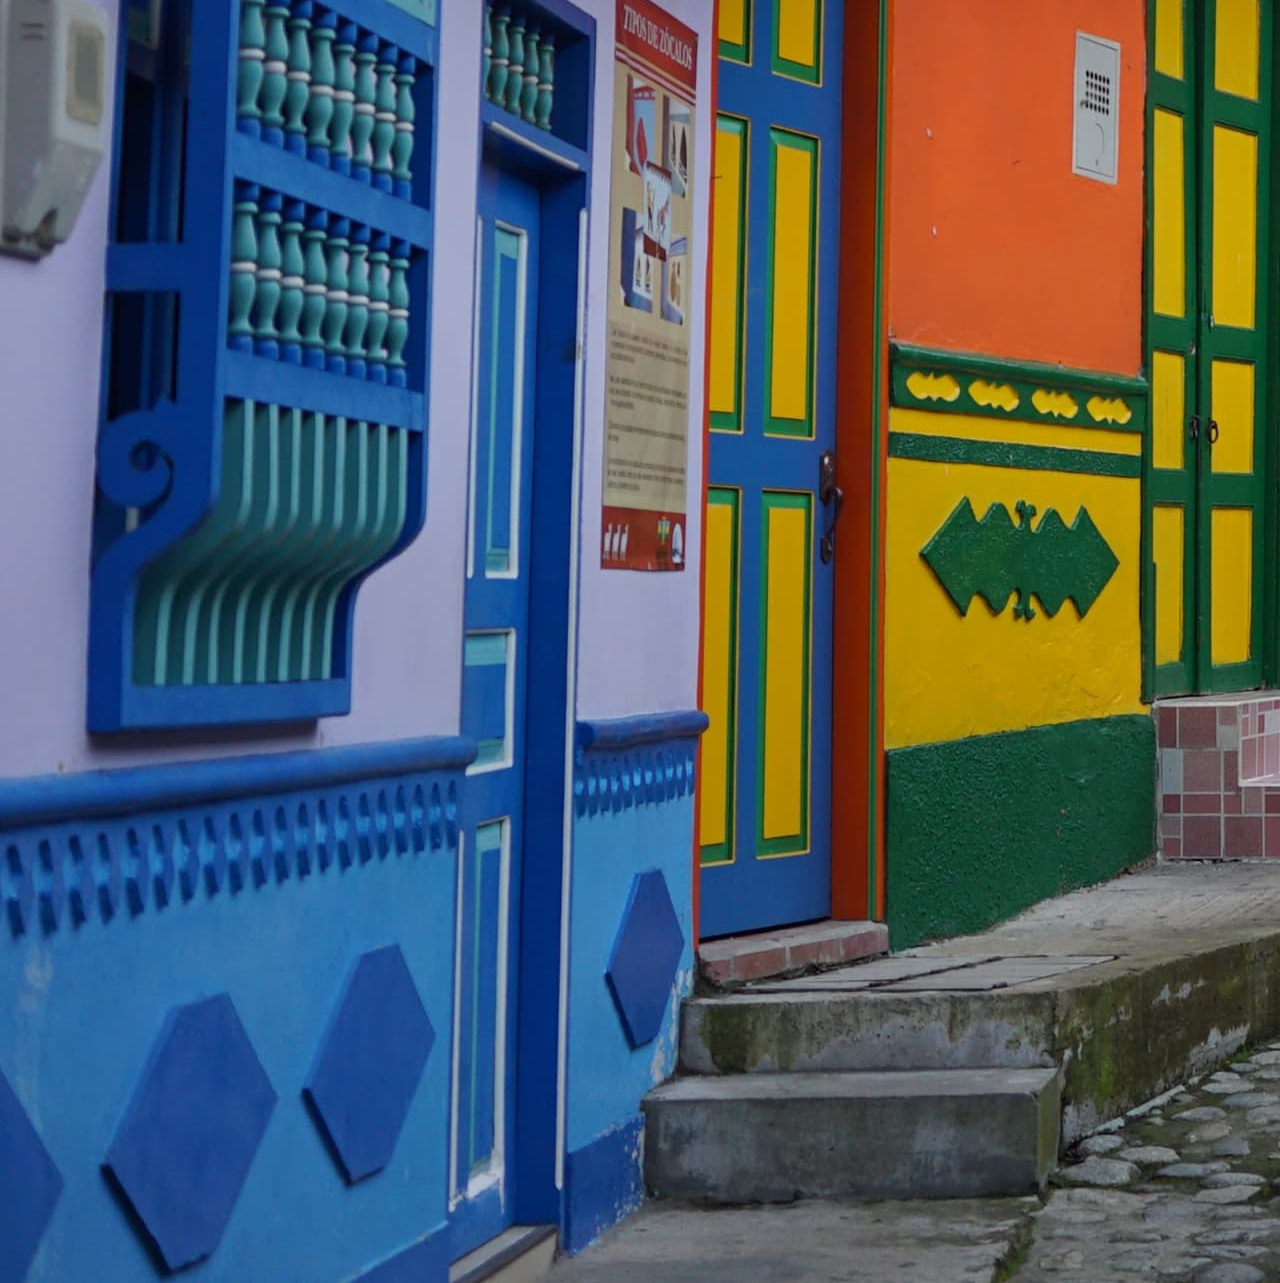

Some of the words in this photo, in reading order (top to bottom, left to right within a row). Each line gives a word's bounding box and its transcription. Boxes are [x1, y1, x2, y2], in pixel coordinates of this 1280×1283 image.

[623, 4, 646, 41] TIPOS
[647, 20, 658, 49] DE
[660, 26, 693, 70] ZÓCALOS
